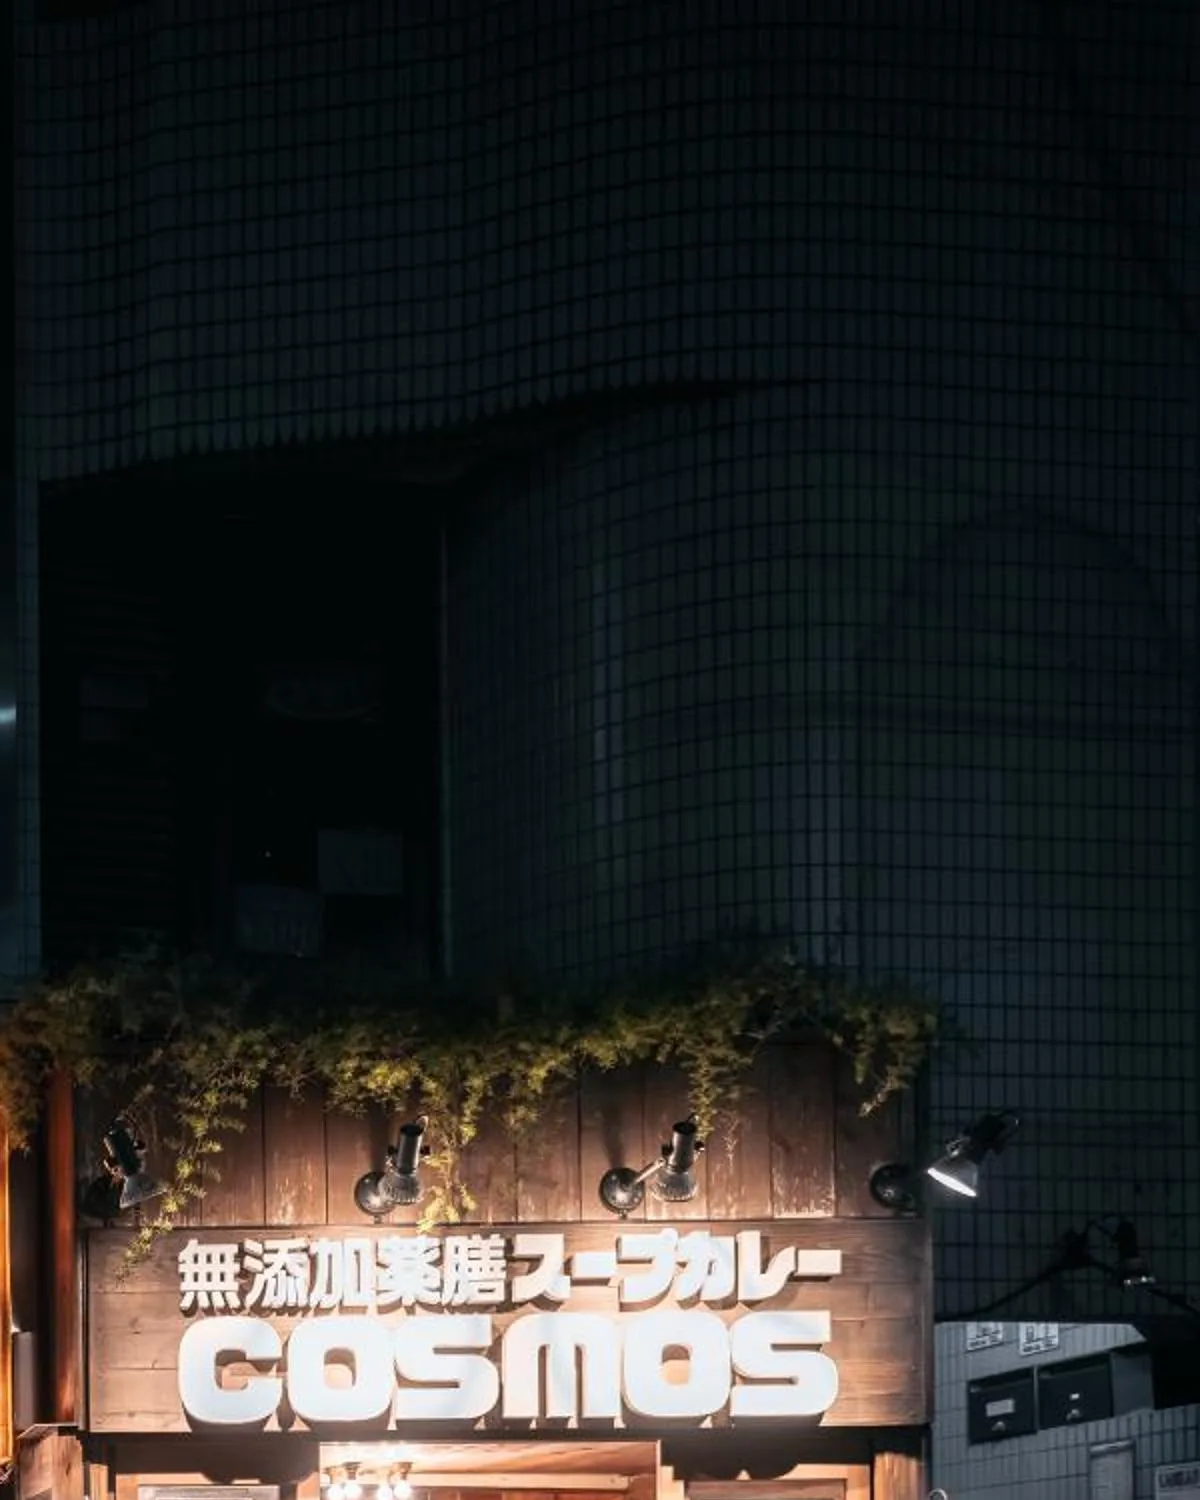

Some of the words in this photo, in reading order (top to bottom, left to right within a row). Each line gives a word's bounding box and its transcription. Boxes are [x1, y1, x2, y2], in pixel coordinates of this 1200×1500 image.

[177, 1228, 842, 1312] 無添加薬膳スープカレー
[177, 1311, 839, 1426] COSMOS
